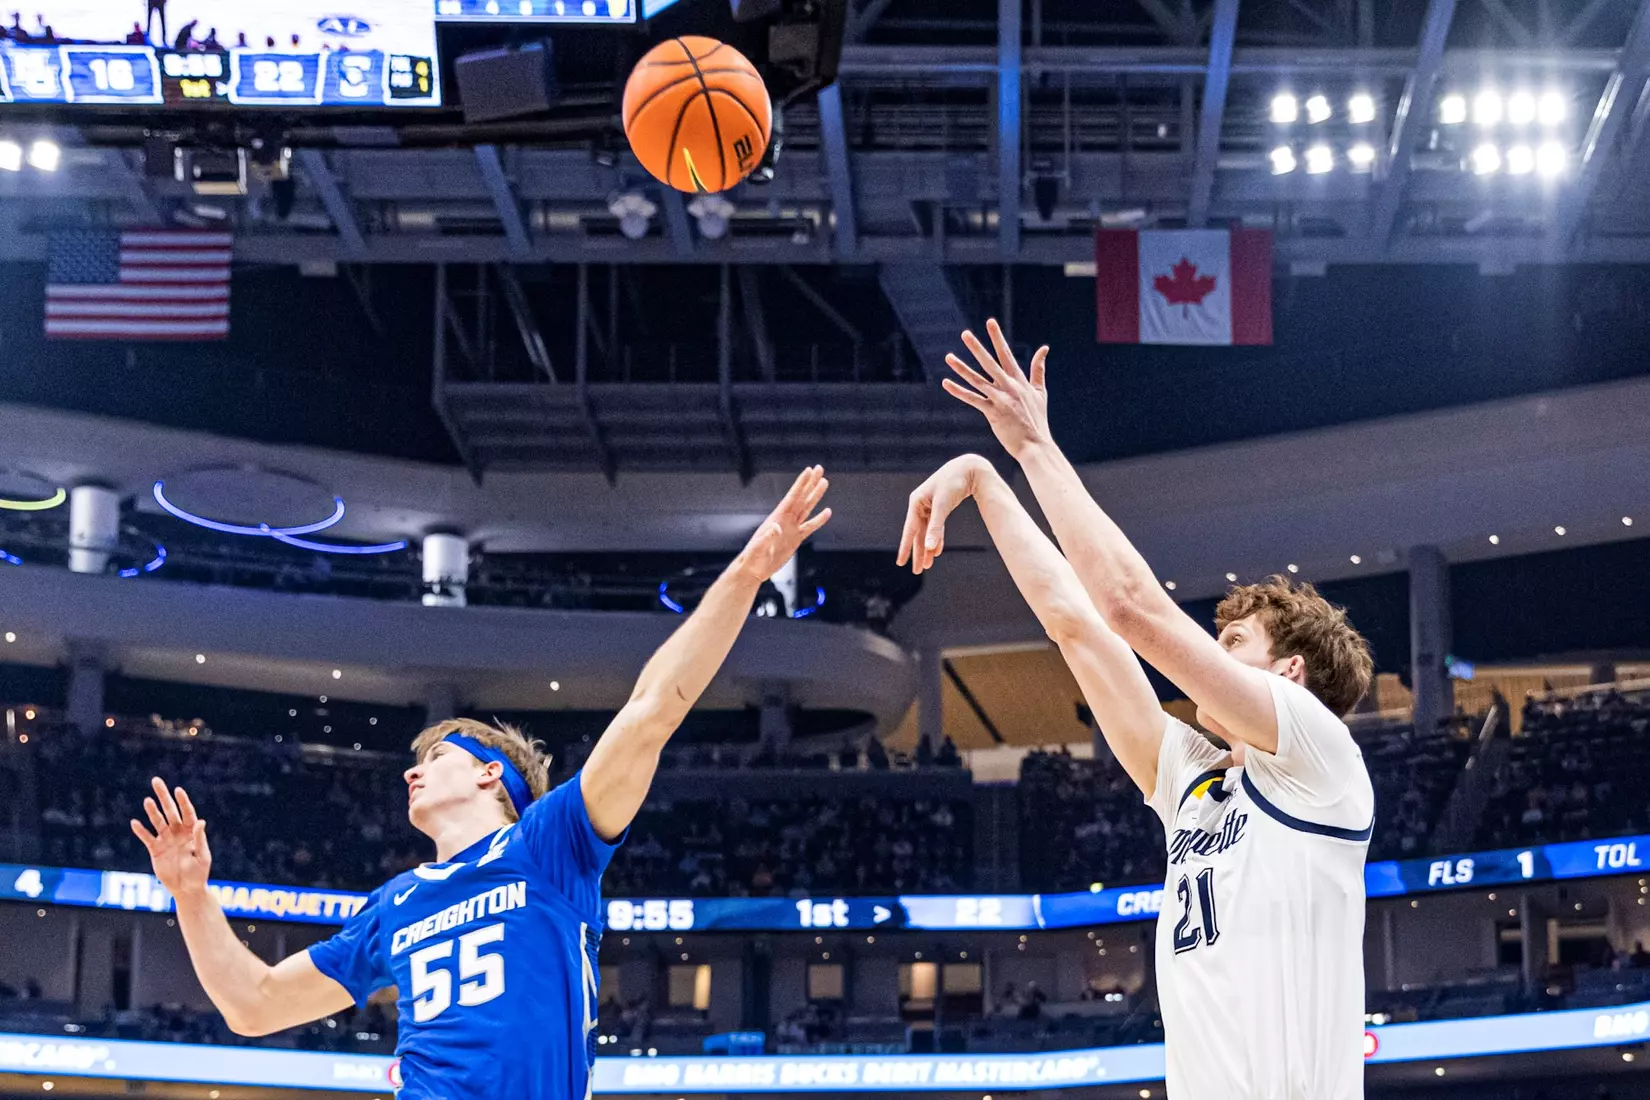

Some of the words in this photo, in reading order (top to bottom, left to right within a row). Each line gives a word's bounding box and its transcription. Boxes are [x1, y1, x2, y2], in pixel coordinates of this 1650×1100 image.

[253, 61, 304, 92] 22
[1428, 858, 1474, 886] FLS
[1516, 850, 1534, 878] 1
[1594, 842, 1642, 869] TOL
[14, 869, 44, 898] 4
[391, 881, 527, 955] CREIGHTON
[607, 899, 695, 931] 9:55
[796, 899, 849, 927] 1st
[955, 898, 1001, 925] 22
[1174, 867, 1220, 956] 21
[409, 922, 506, 1023] 55
